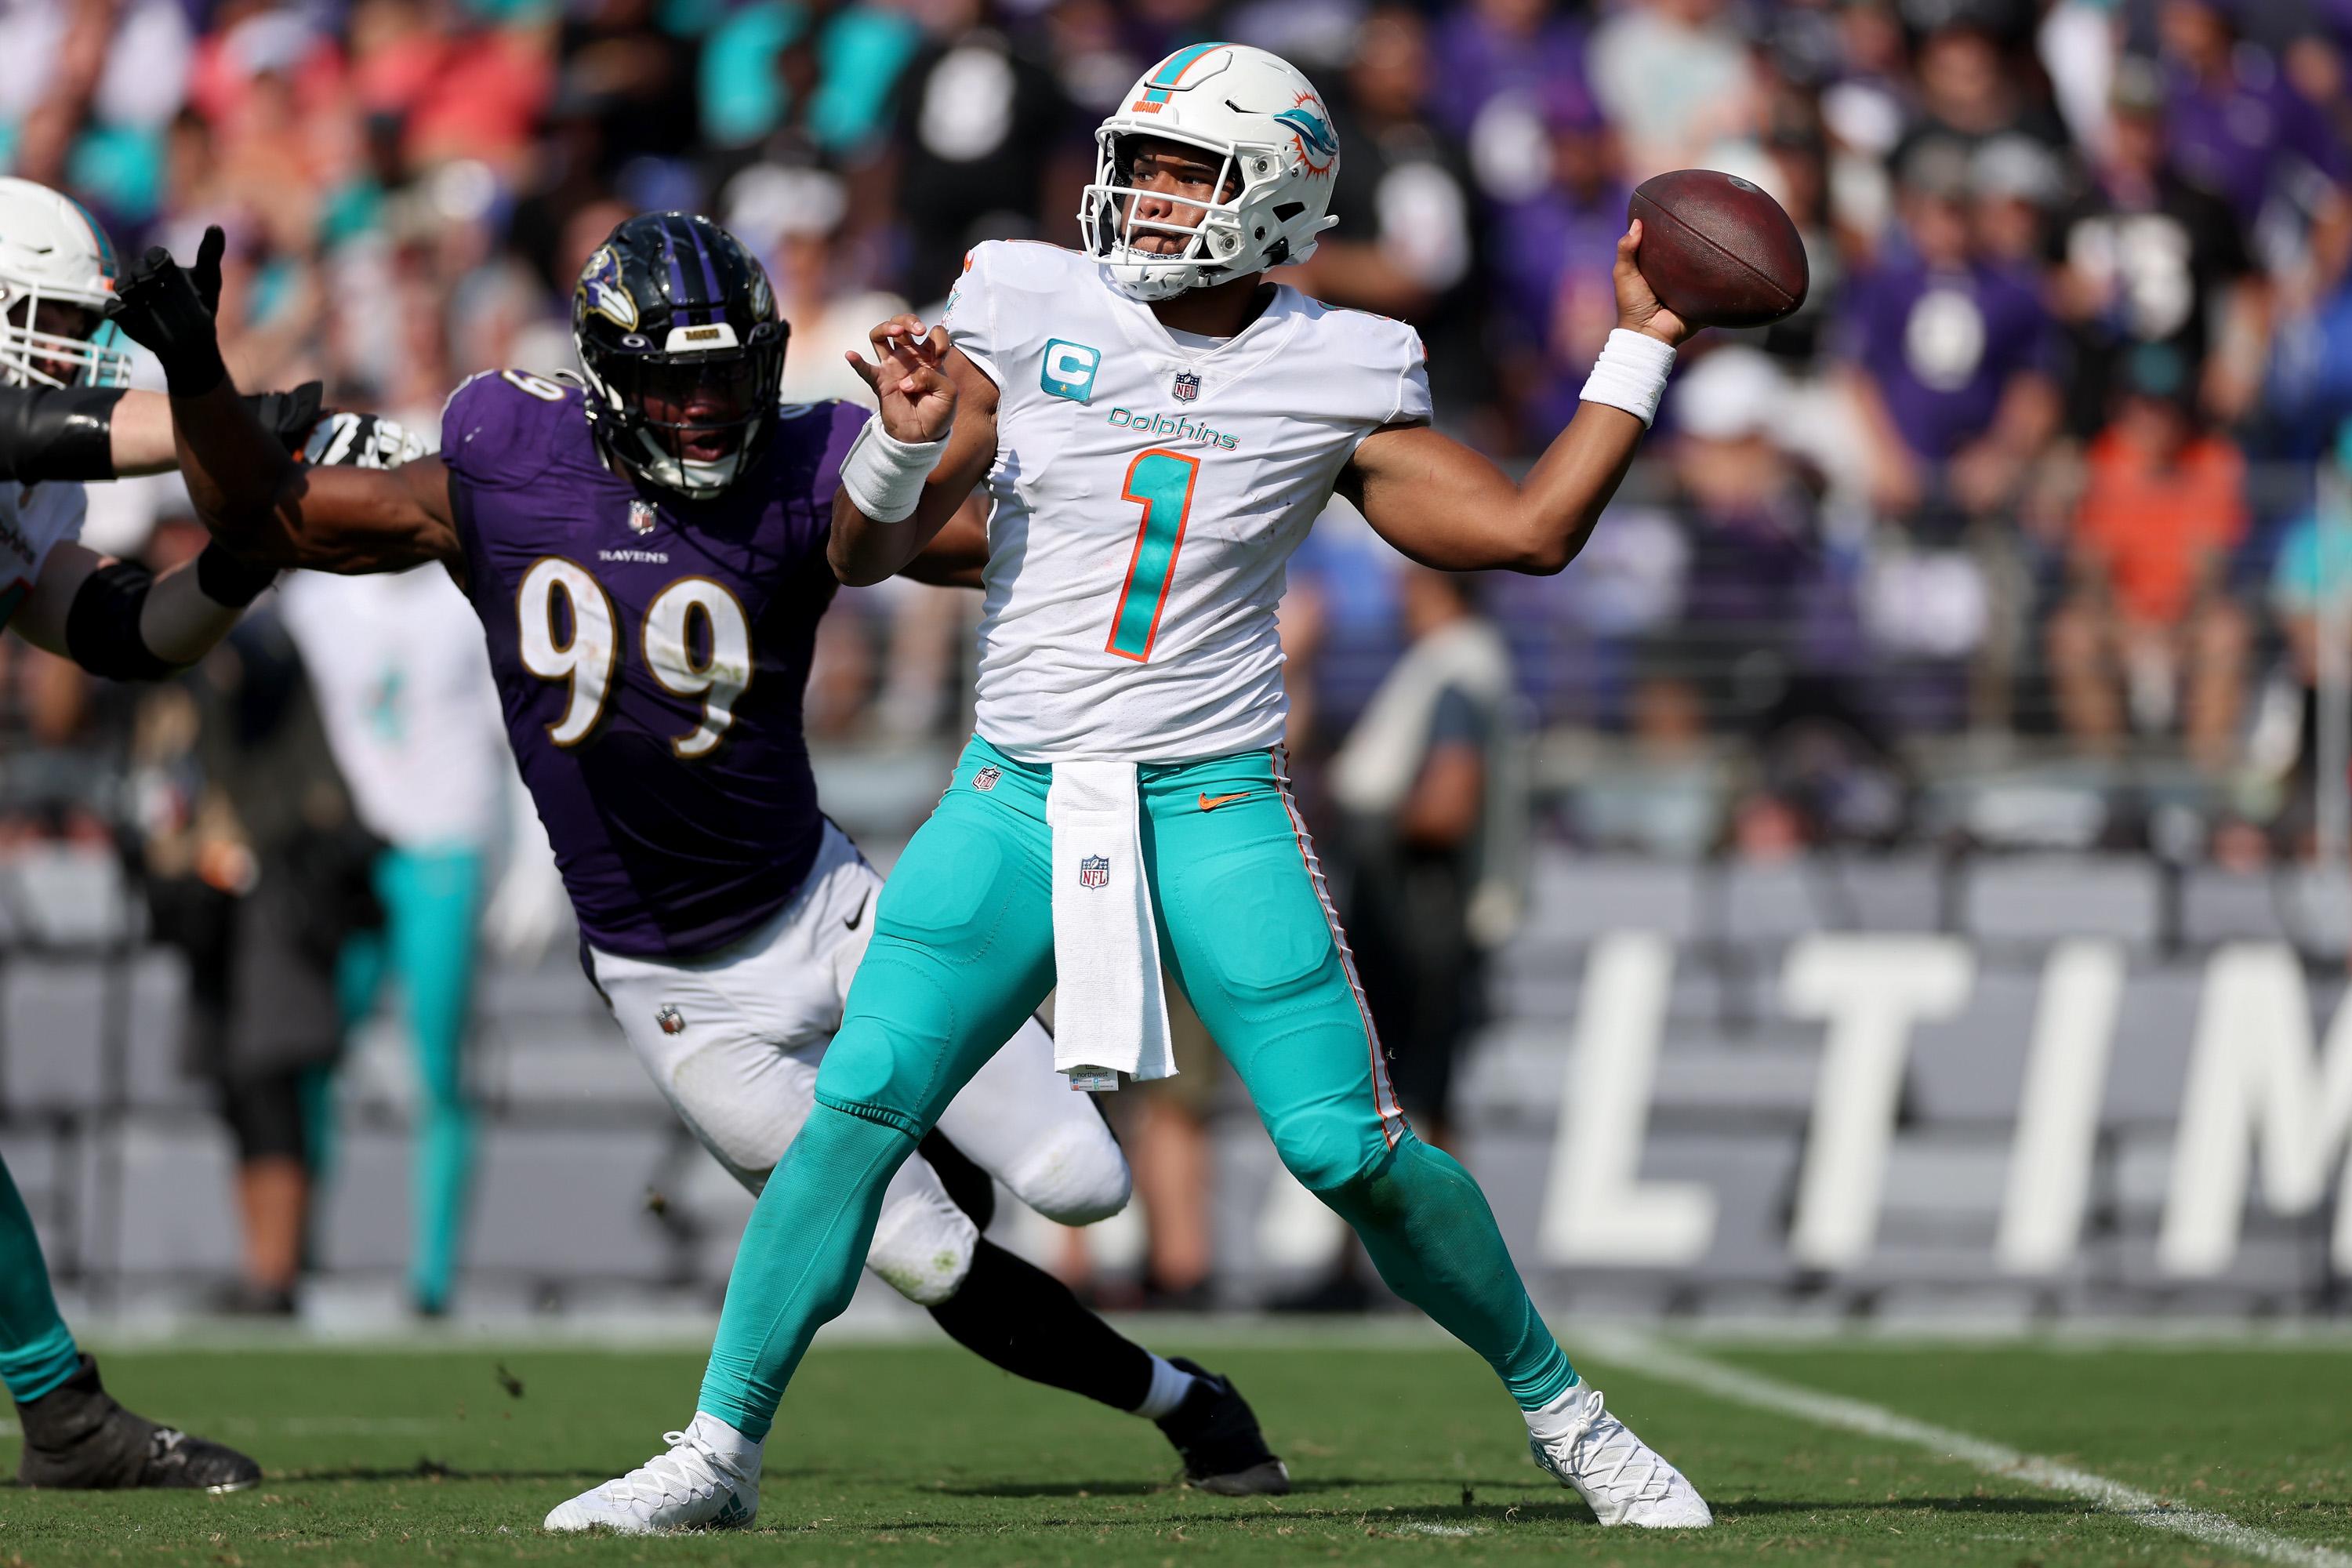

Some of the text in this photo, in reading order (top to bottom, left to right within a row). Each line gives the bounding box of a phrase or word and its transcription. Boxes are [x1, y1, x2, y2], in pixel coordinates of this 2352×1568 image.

[1046, 343, 1094, 385] C
[1107, 407, 1240, 451] Dolphins
[597, 550, 669, 564] RAVENS
[1105, 448, 1201, 664] 1
[515, 554, 754, 759] 99
